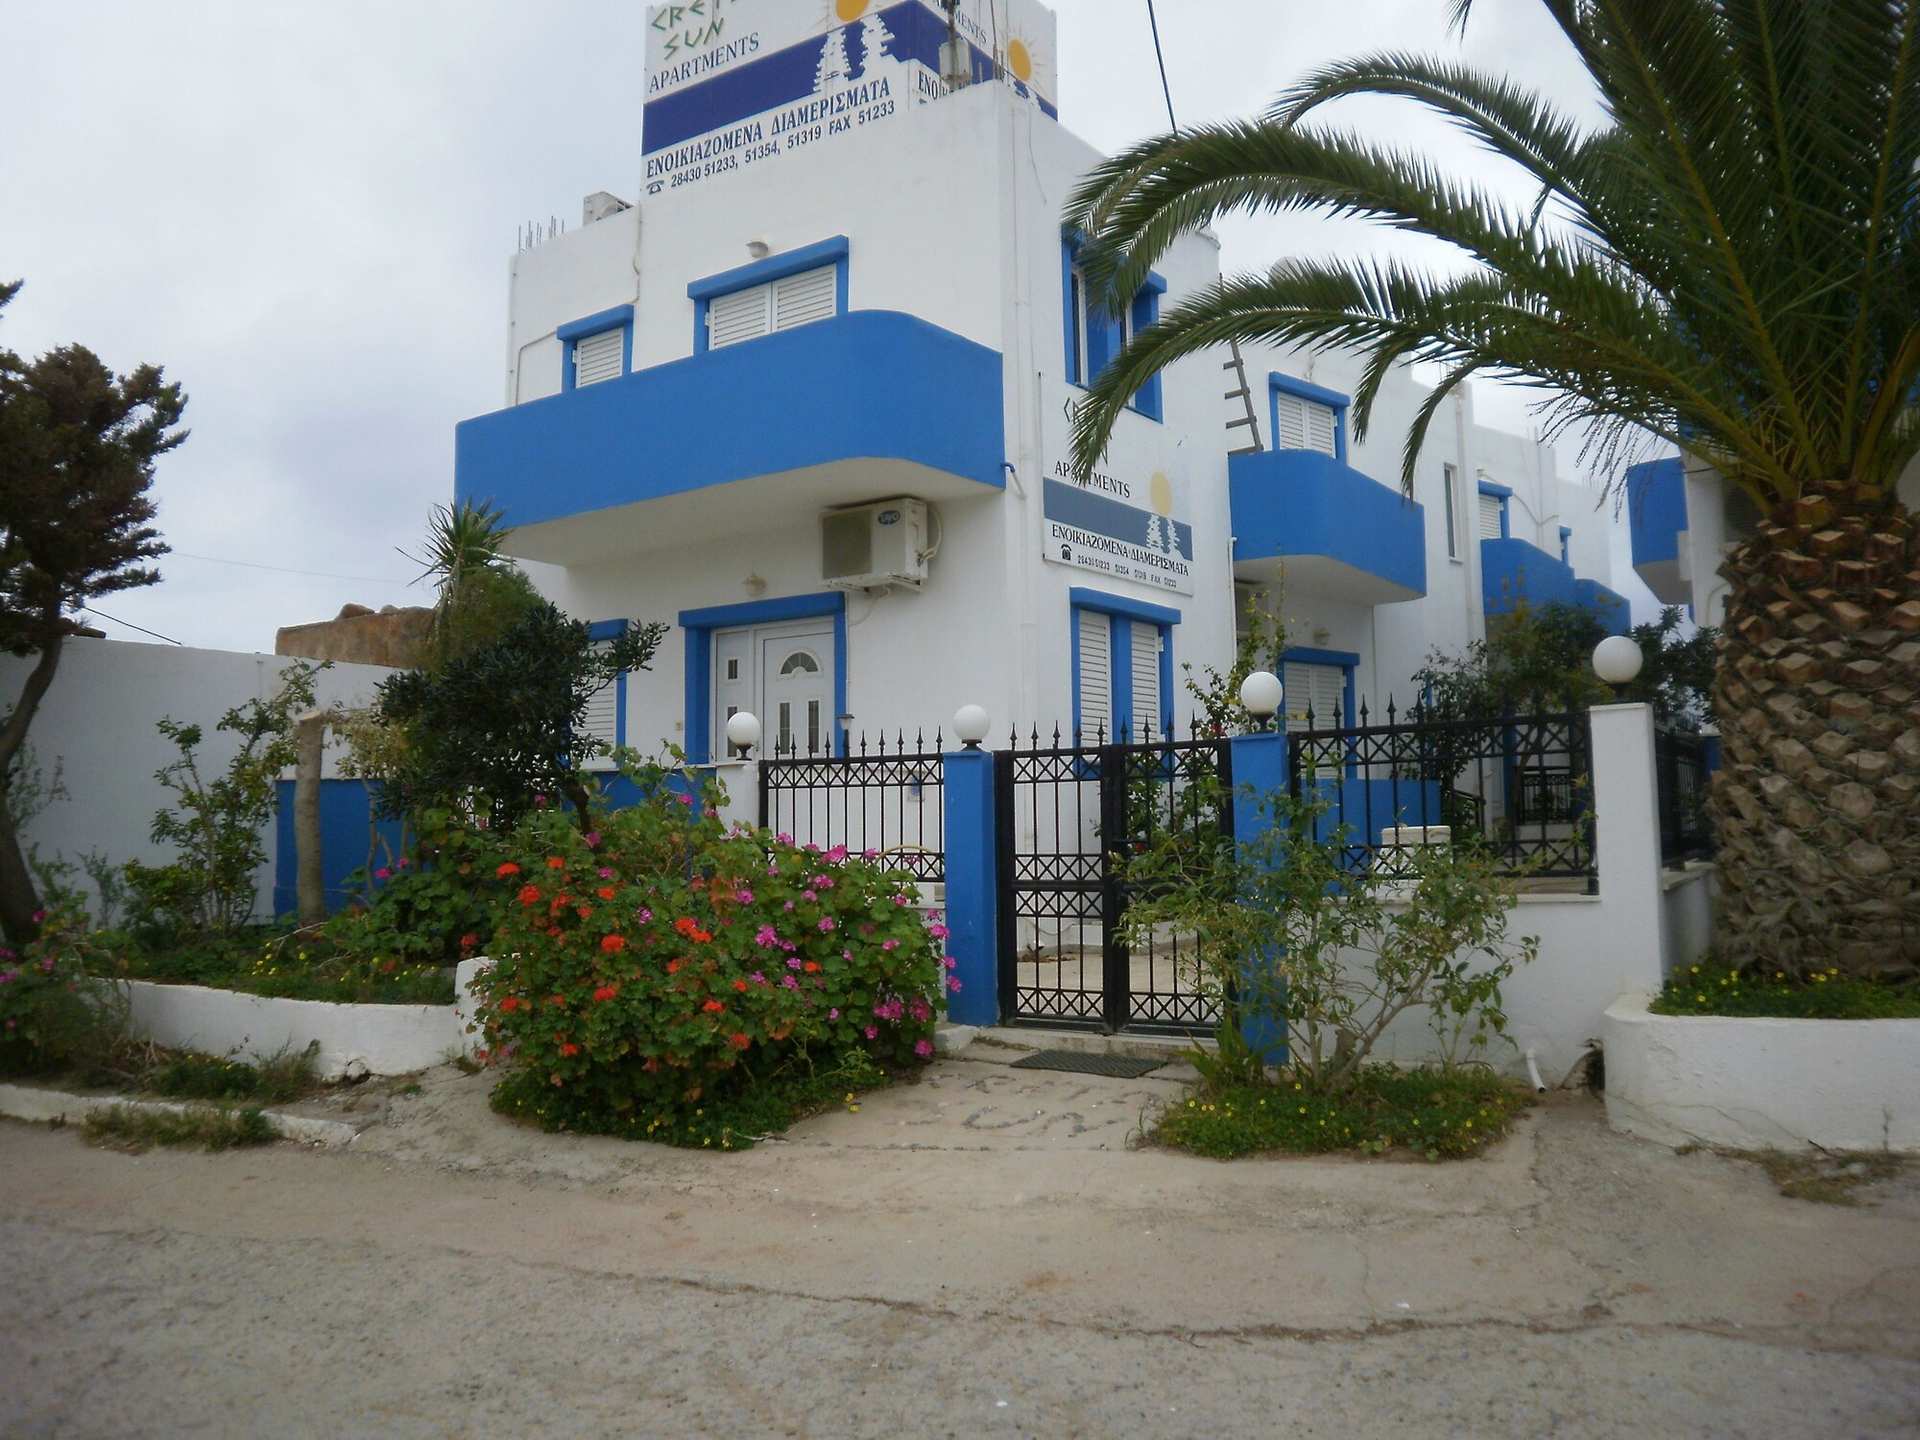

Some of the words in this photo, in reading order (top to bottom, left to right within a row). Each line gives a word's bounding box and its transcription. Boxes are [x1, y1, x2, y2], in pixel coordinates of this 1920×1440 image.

[649, 32, 759, 93] APARTMENTS
[663, 17, 724, 60] SUN
[646, 121, 762, 178] ΕΝΟΙΚΙΑΖΟΜΕΝΑ
[771, 76, 890, 135] ΔΙΑΜΕΡΙΣΜΑΤΑ
[671, 166, 701, 188] 28430
[704, 155, 738, 177] 51233,
[744, 140, 780, 163] 51354,
[787, 125, 821, 149] 51319
[829, 115, 851, 135] FAX
[858, 100, 895, 125] 51233
[1055, 460, 1130, 498] APTMENTS
